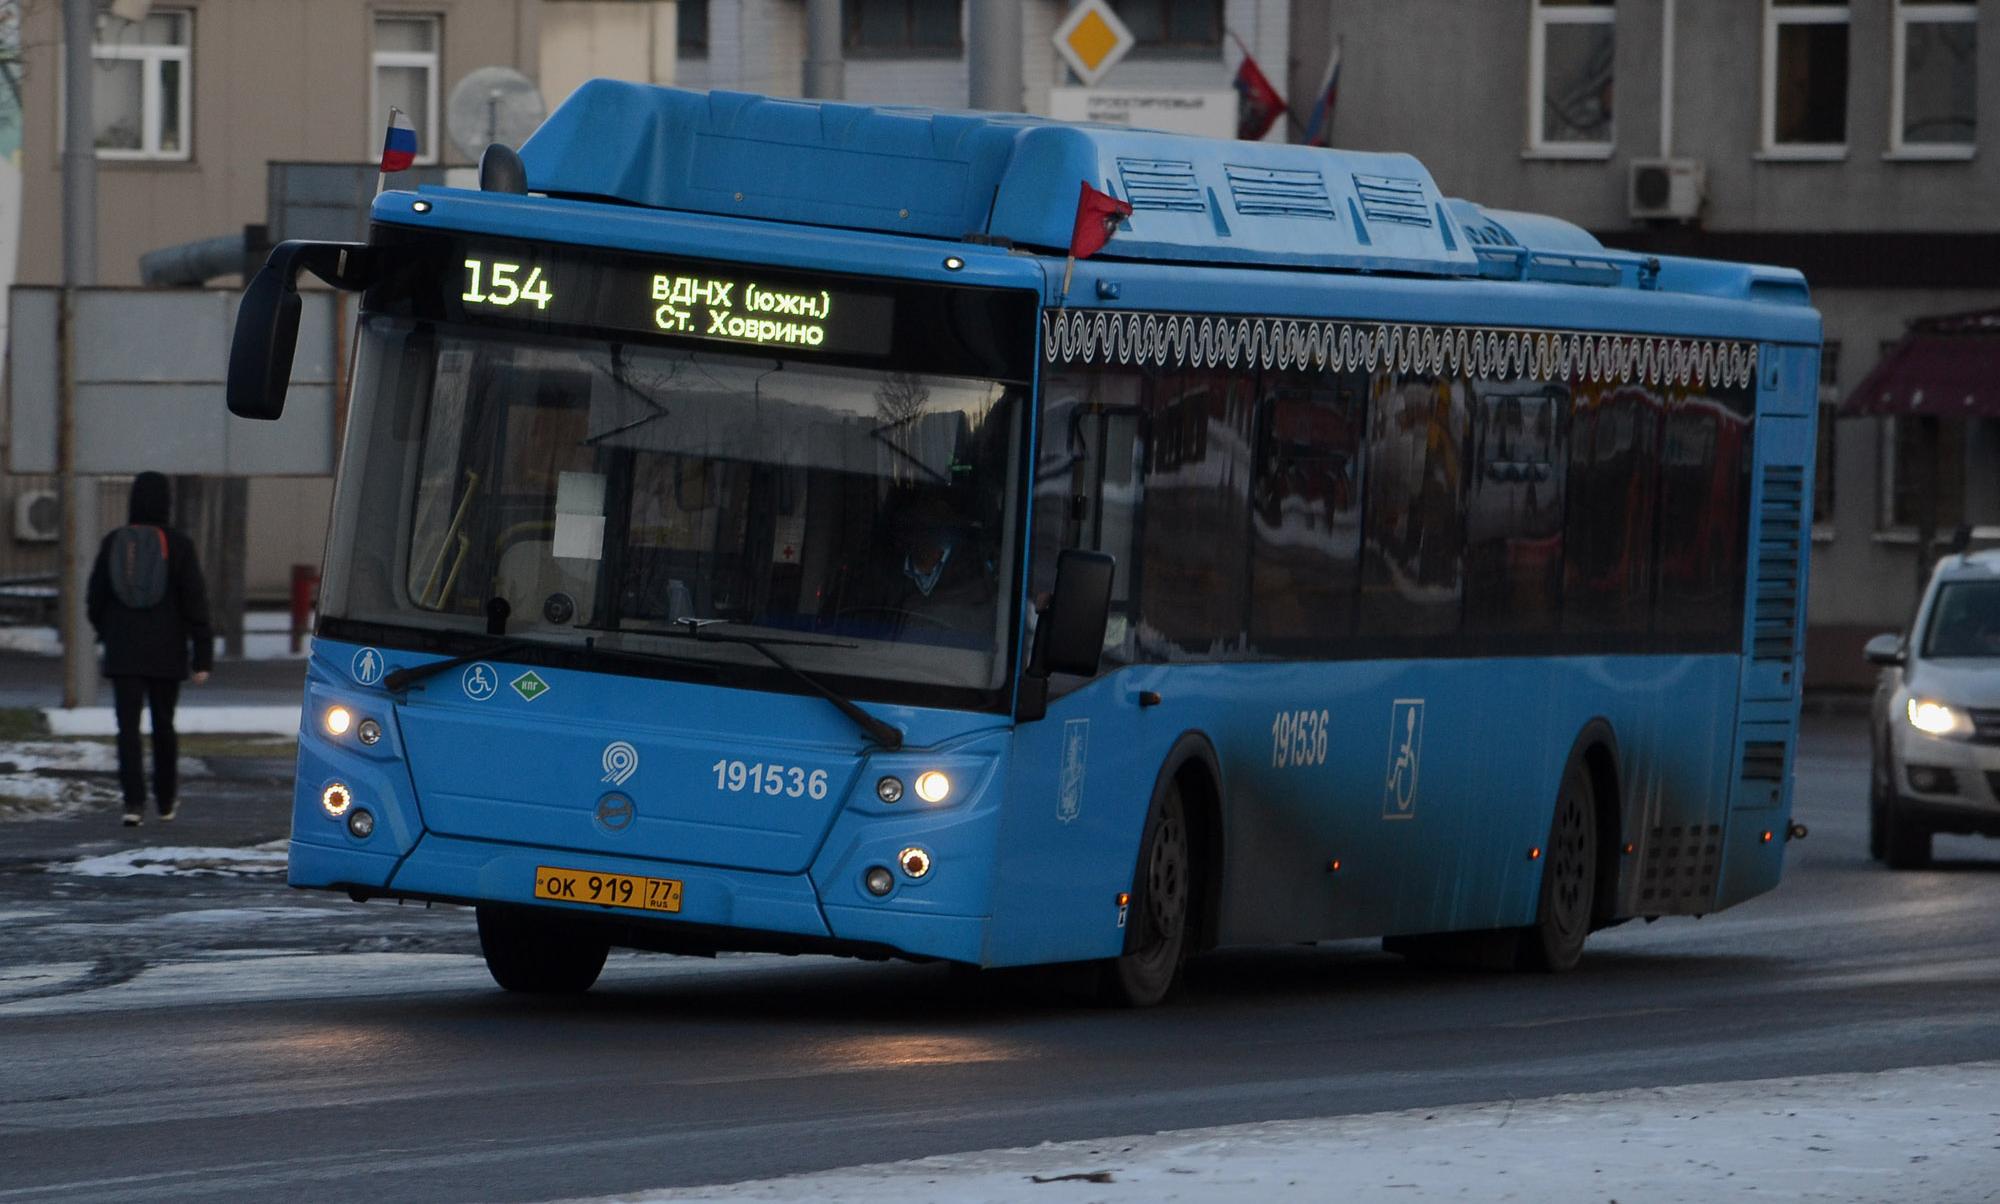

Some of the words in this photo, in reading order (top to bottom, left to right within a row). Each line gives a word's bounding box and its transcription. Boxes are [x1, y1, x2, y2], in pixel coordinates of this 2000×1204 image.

[462, 259, 553, 309] 154
[651, 275, 734, 307] ВДНХ
[745, 284, 830, 318] (южн.)
[654, 304, 695, 332] Ст.
[705, 309, 825, 346] Ховрино
[1271, 709, 1330, 769] 191536
[711, 759, 829, 801] 191536
[588, 876, 634, 903] 919
[649, 880, 673, 900] 77
[650, 899, 668, 908] RUS
